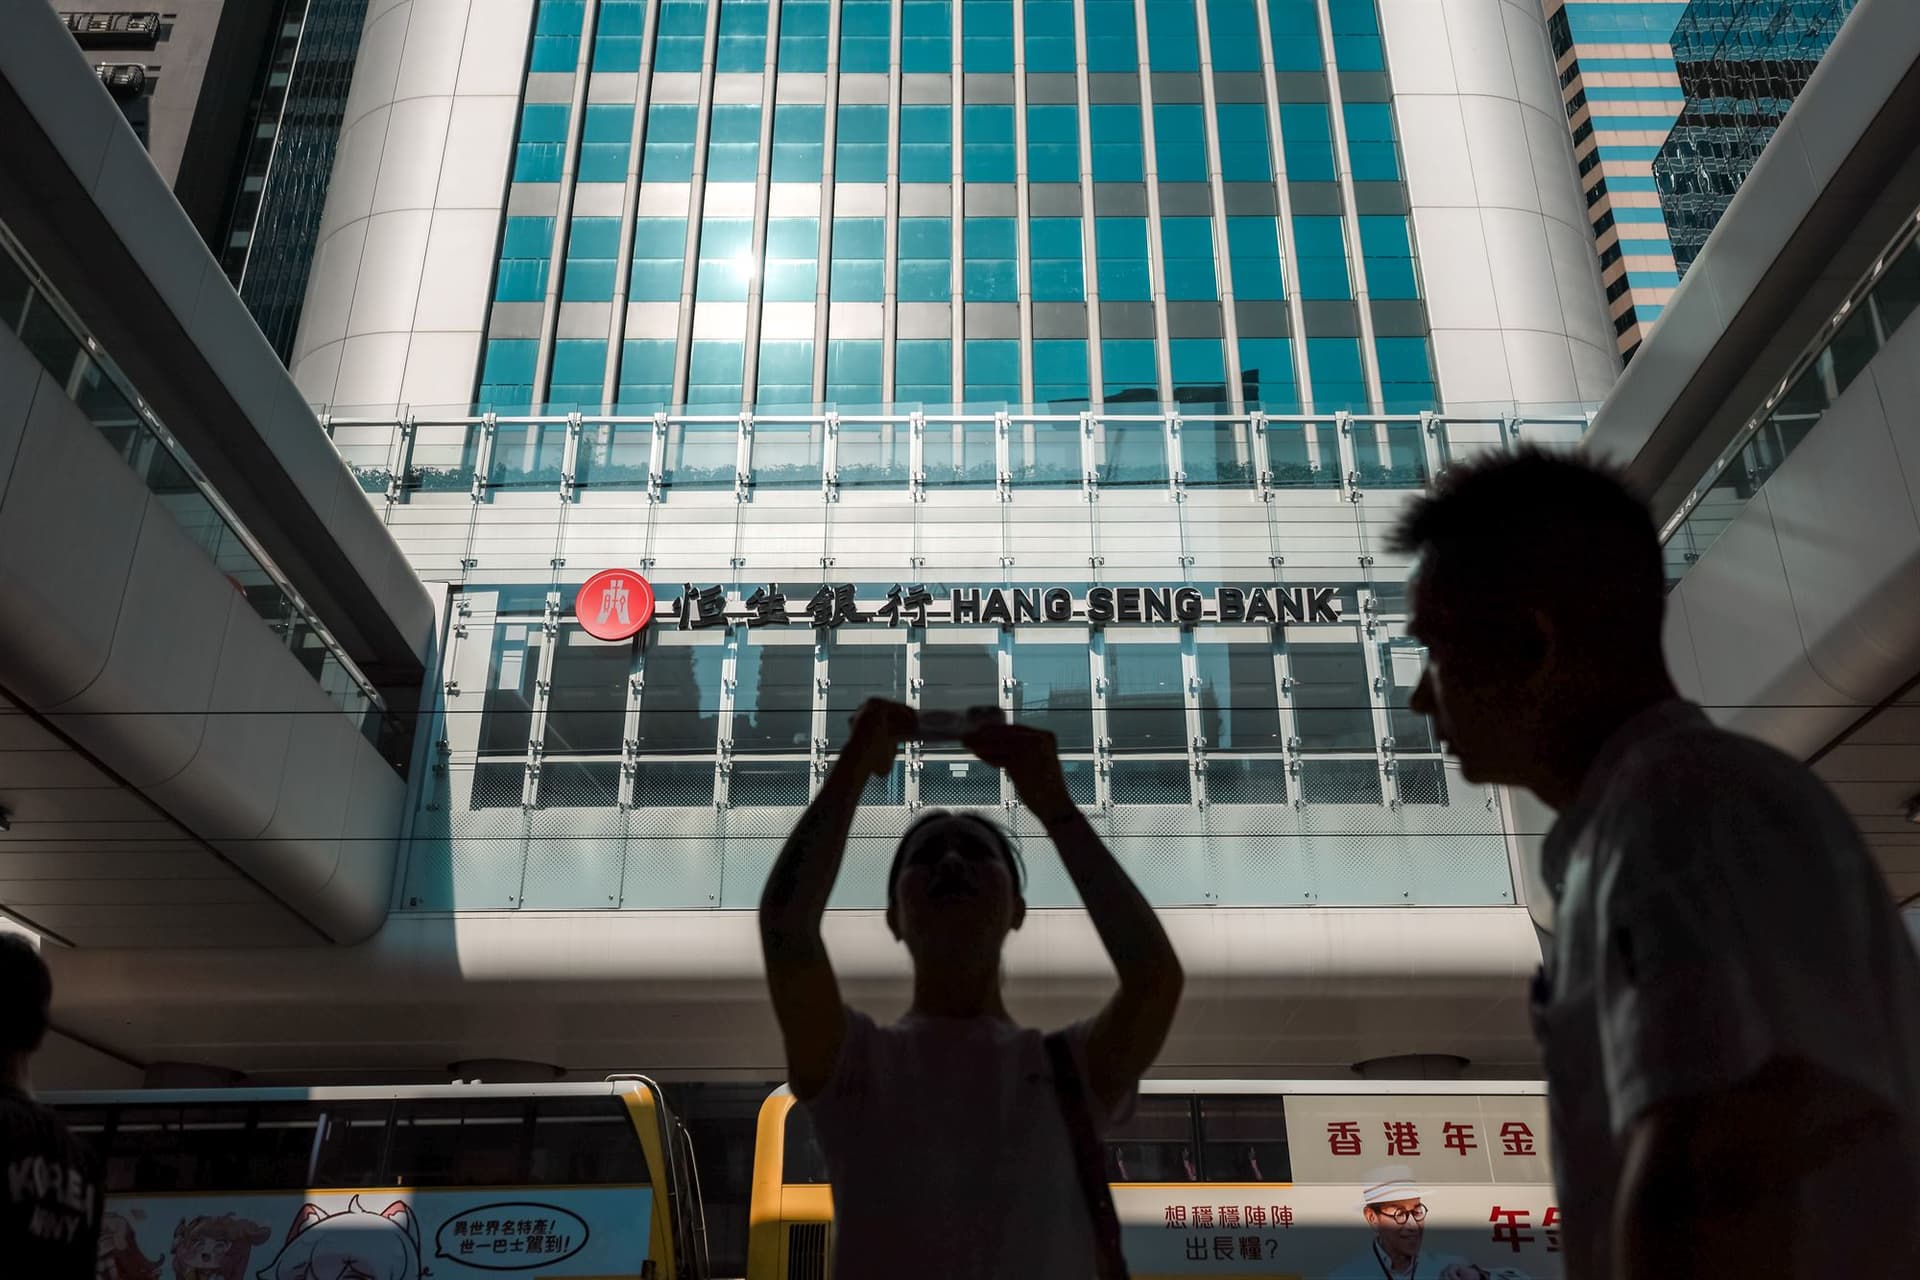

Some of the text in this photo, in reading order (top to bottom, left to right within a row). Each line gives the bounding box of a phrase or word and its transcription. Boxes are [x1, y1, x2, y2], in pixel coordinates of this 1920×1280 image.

[672, 582, 1342, 631] 恒生銀行 HANG SENG BANK
[1327, 1121, 1536, 1157] 香港年金
[1164, 1205, 1295, 1229] 想穩穩陣陣
[1185, 1236, 1279, 1261] 出長糧?
